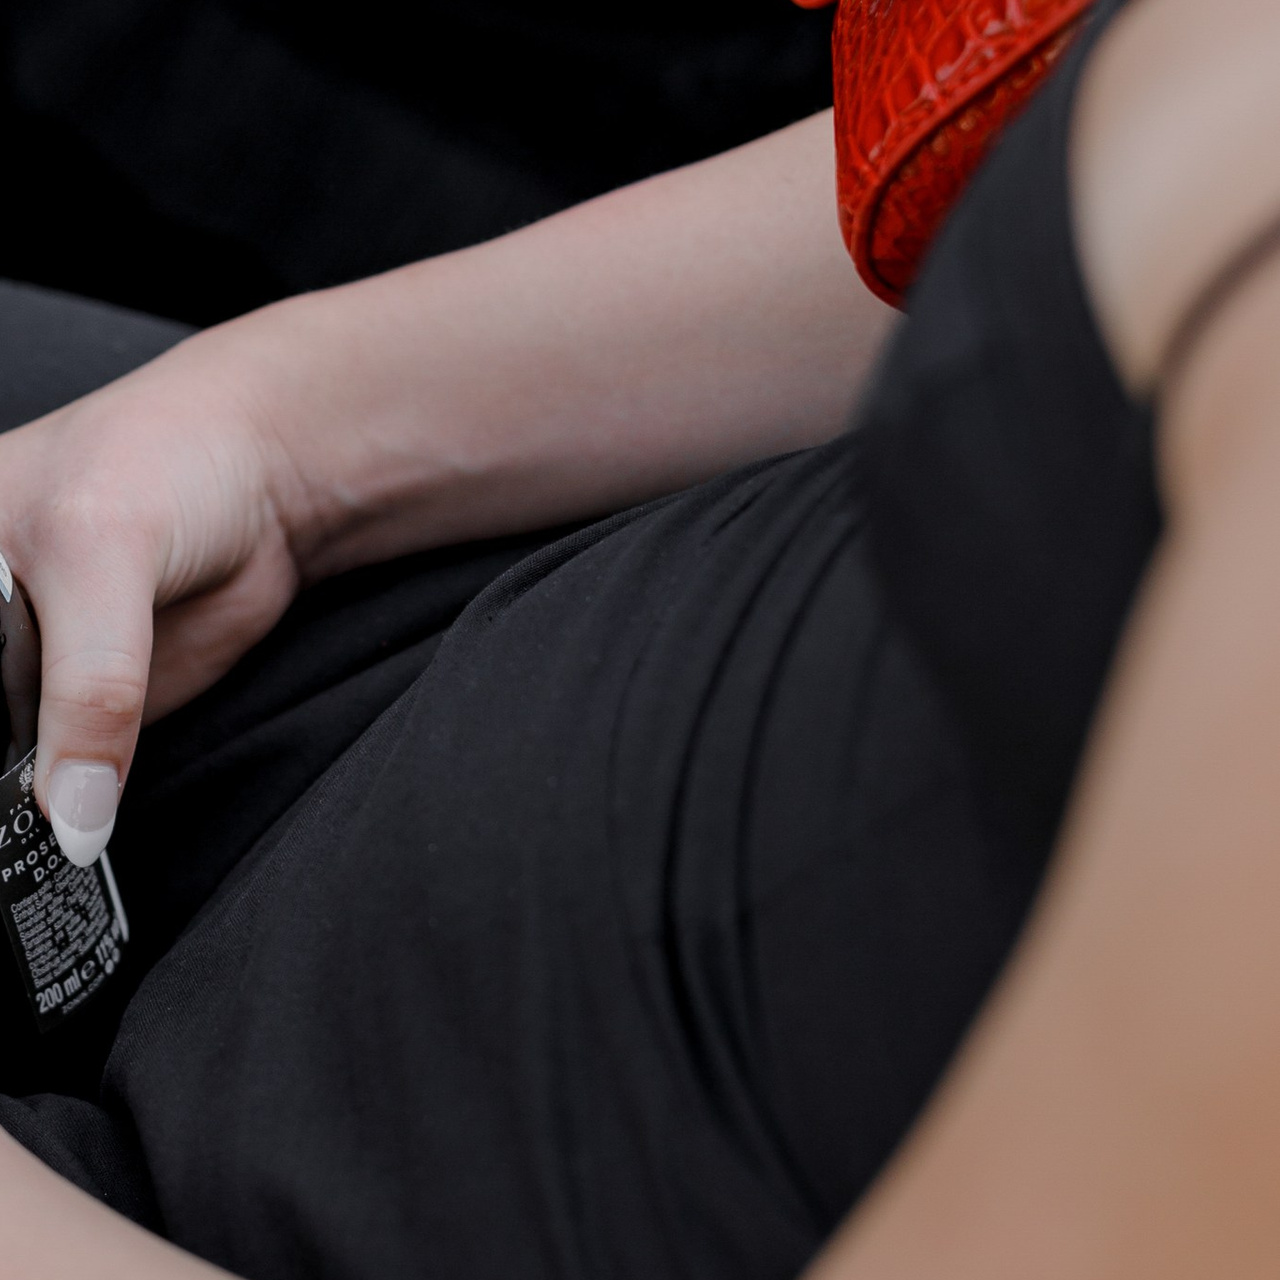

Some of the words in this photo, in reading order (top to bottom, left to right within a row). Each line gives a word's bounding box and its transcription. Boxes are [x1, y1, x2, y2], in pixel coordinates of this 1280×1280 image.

[10, 795, 30, 816] FAM
[1, 832, 58, 882] PROSE
[35, 982, 64, 1014] 200
[63, 967, 82, 997] ml
